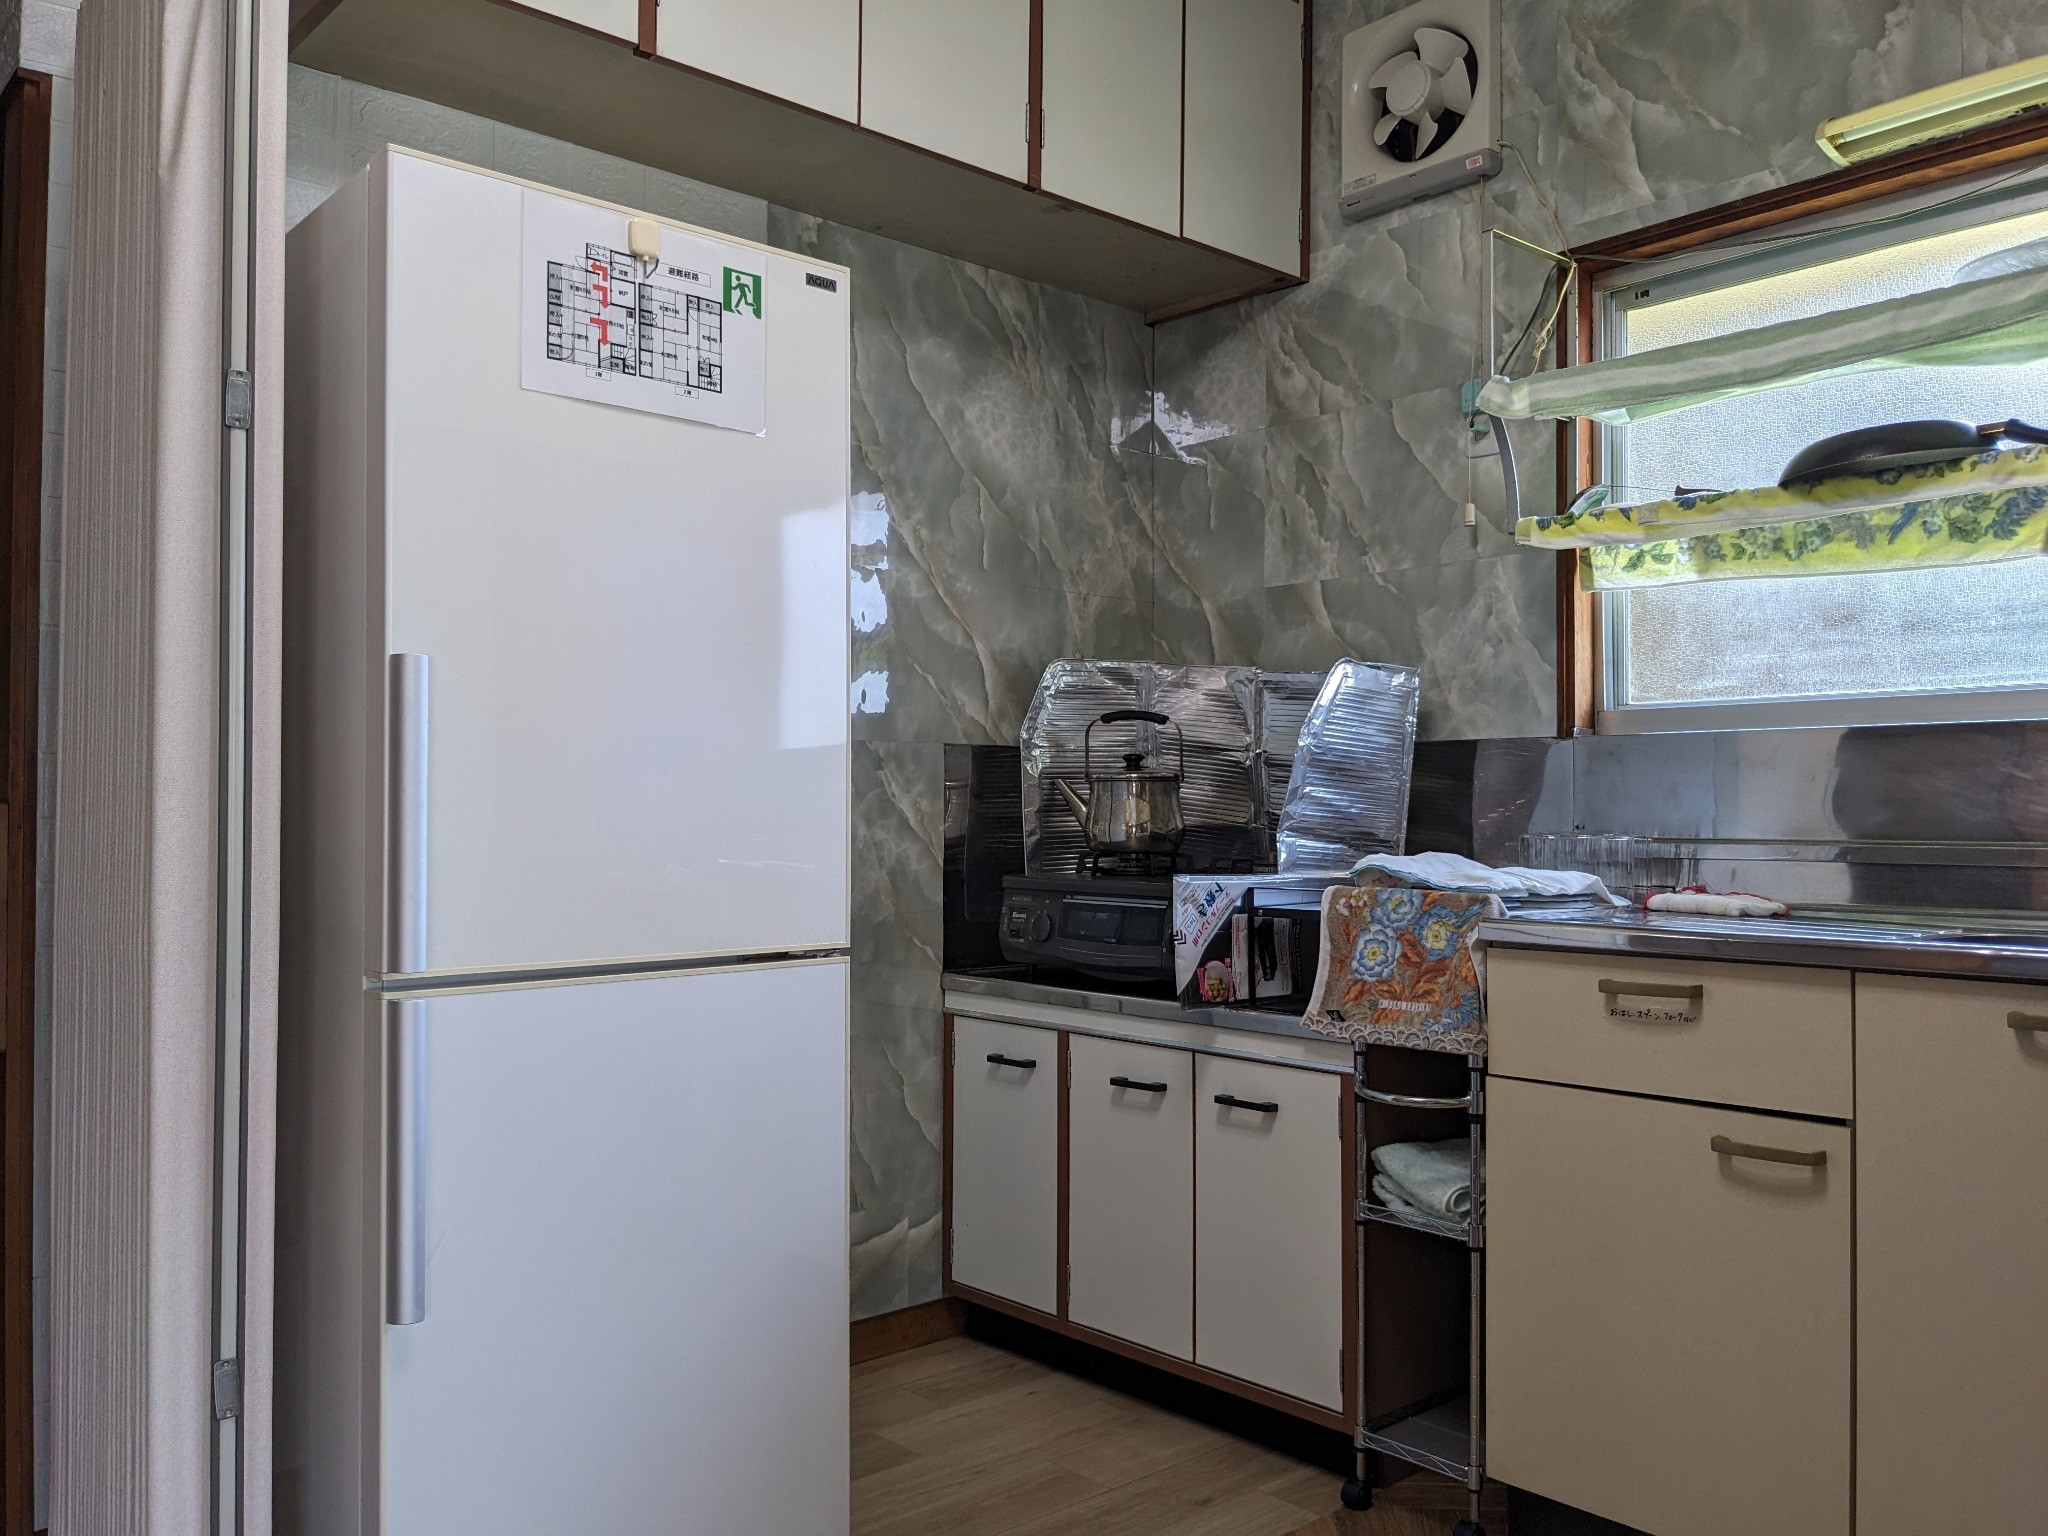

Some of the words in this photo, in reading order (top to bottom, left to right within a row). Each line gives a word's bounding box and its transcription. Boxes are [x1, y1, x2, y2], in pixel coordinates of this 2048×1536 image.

[549, 273, 561, 281] 押入
[667, 267, 700, 282] 避難経路
[807, 276, 836, 290] AQUA
[640, 293, 651, 302] 押入
[705, 303, 715, 311] 押入
[549, 311, 561, 319] 押入
[641, 334, 651, 342] 押入
[1194, 881, 1227, 919] 下敷き
[1191, 889, 1232, 948] テーブルコンロ用
